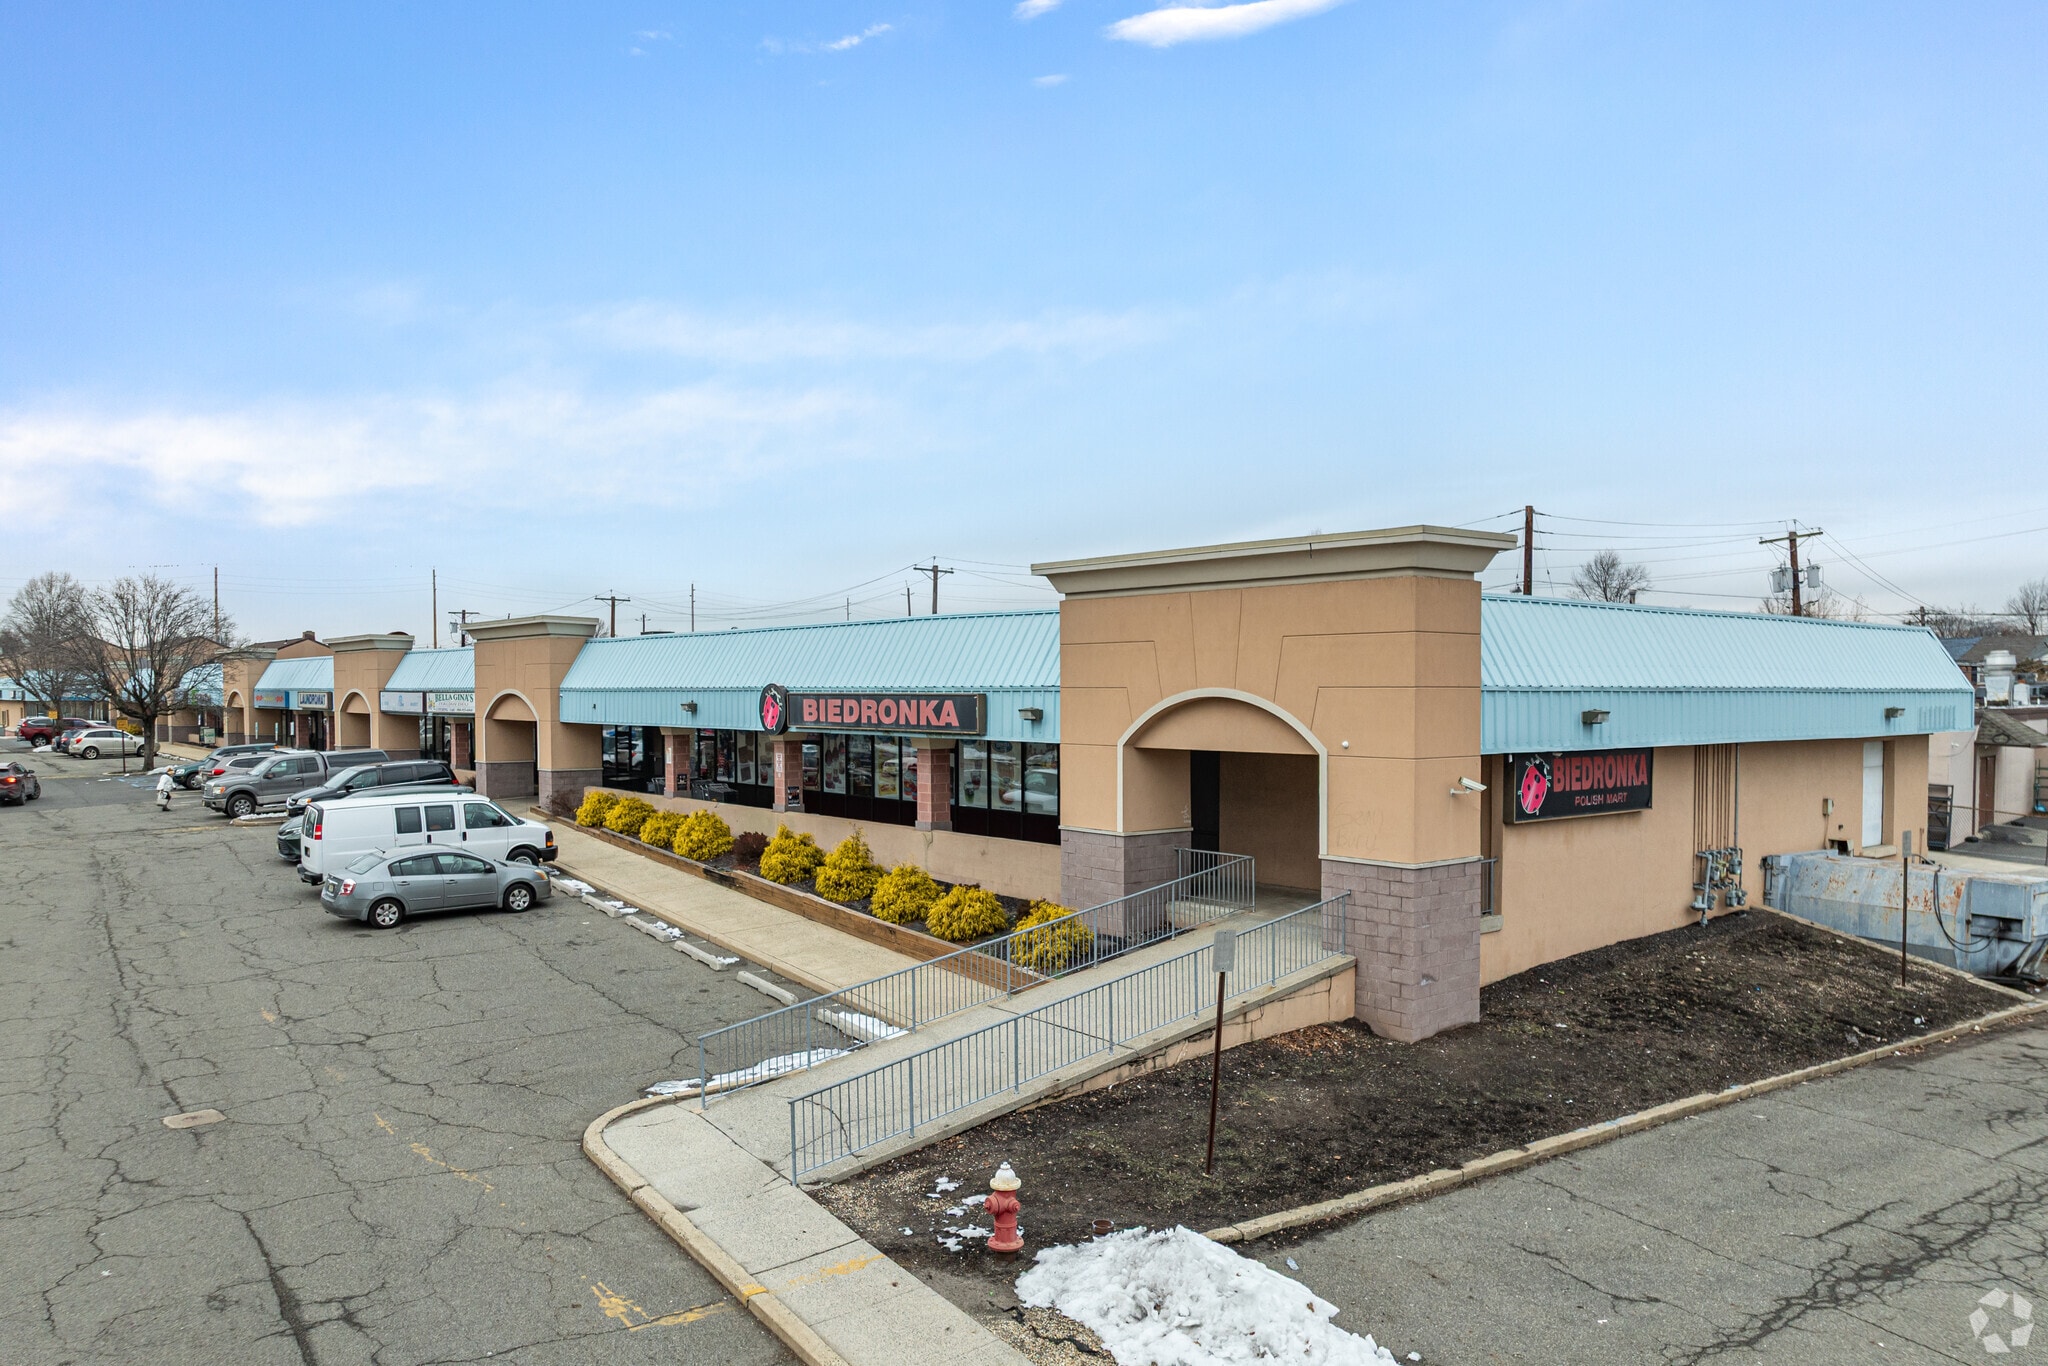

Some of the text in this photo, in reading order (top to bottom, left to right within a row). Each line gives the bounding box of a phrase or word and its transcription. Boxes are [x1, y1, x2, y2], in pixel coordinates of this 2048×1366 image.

[300, 693, 326, 705] LAUNDROMAT
[435, 693, 474, 703] BELLA GINA'S
[803, 698, 959, 727] BIEDRONKA
[1553, 754, 1648, 792] BIEDRONKA
[1575, 793, 1628, 806] POLISH MART
